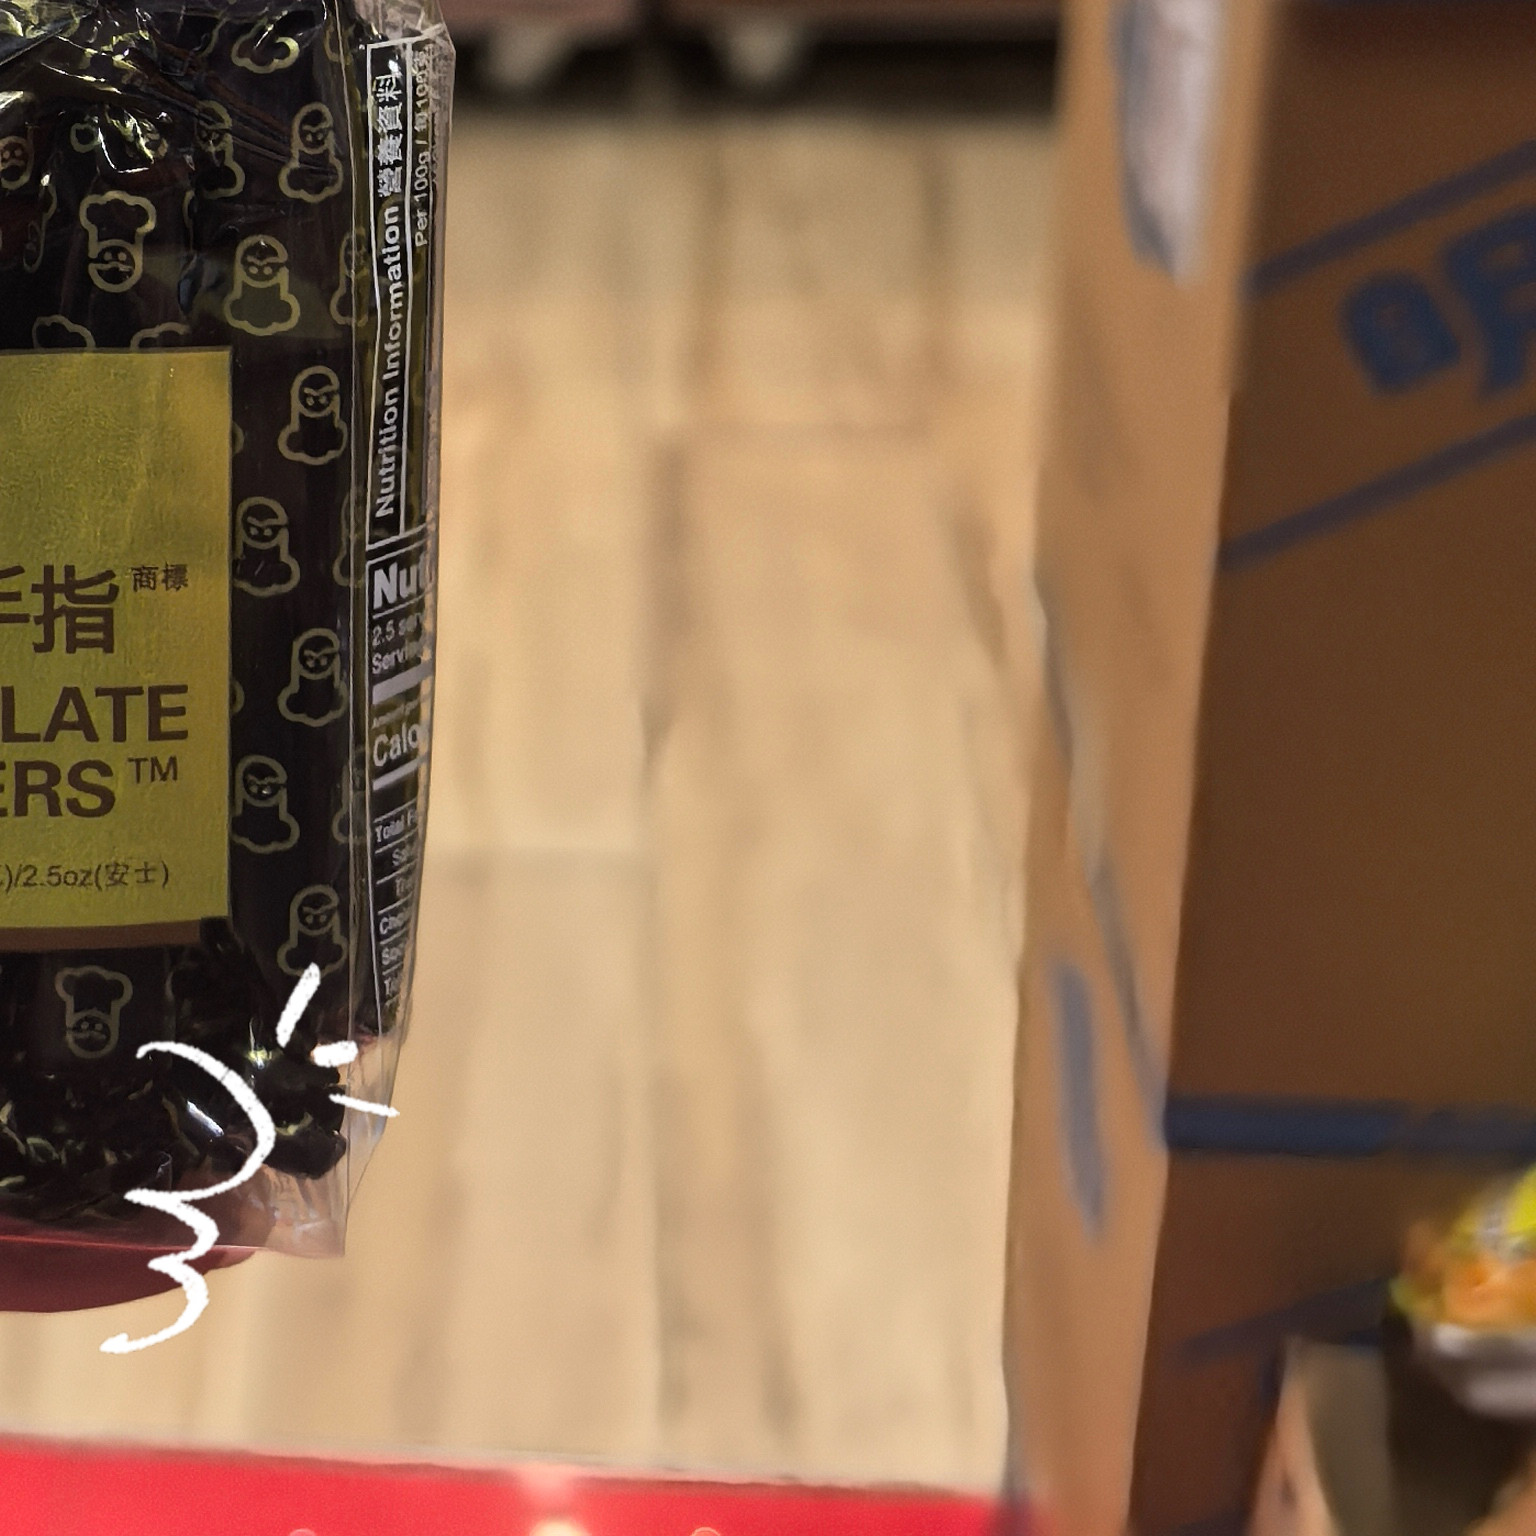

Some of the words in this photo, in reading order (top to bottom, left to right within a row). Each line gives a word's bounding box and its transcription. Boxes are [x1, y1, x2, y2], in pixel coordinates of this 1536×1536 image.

[414, 151, 431, 200] 100g
[414, 208, 429, 247] Per
[382, 205, 405, 382] Information
[375, 385, 401, 519] Nutrition
[131, 561, 189, 592] 商標
